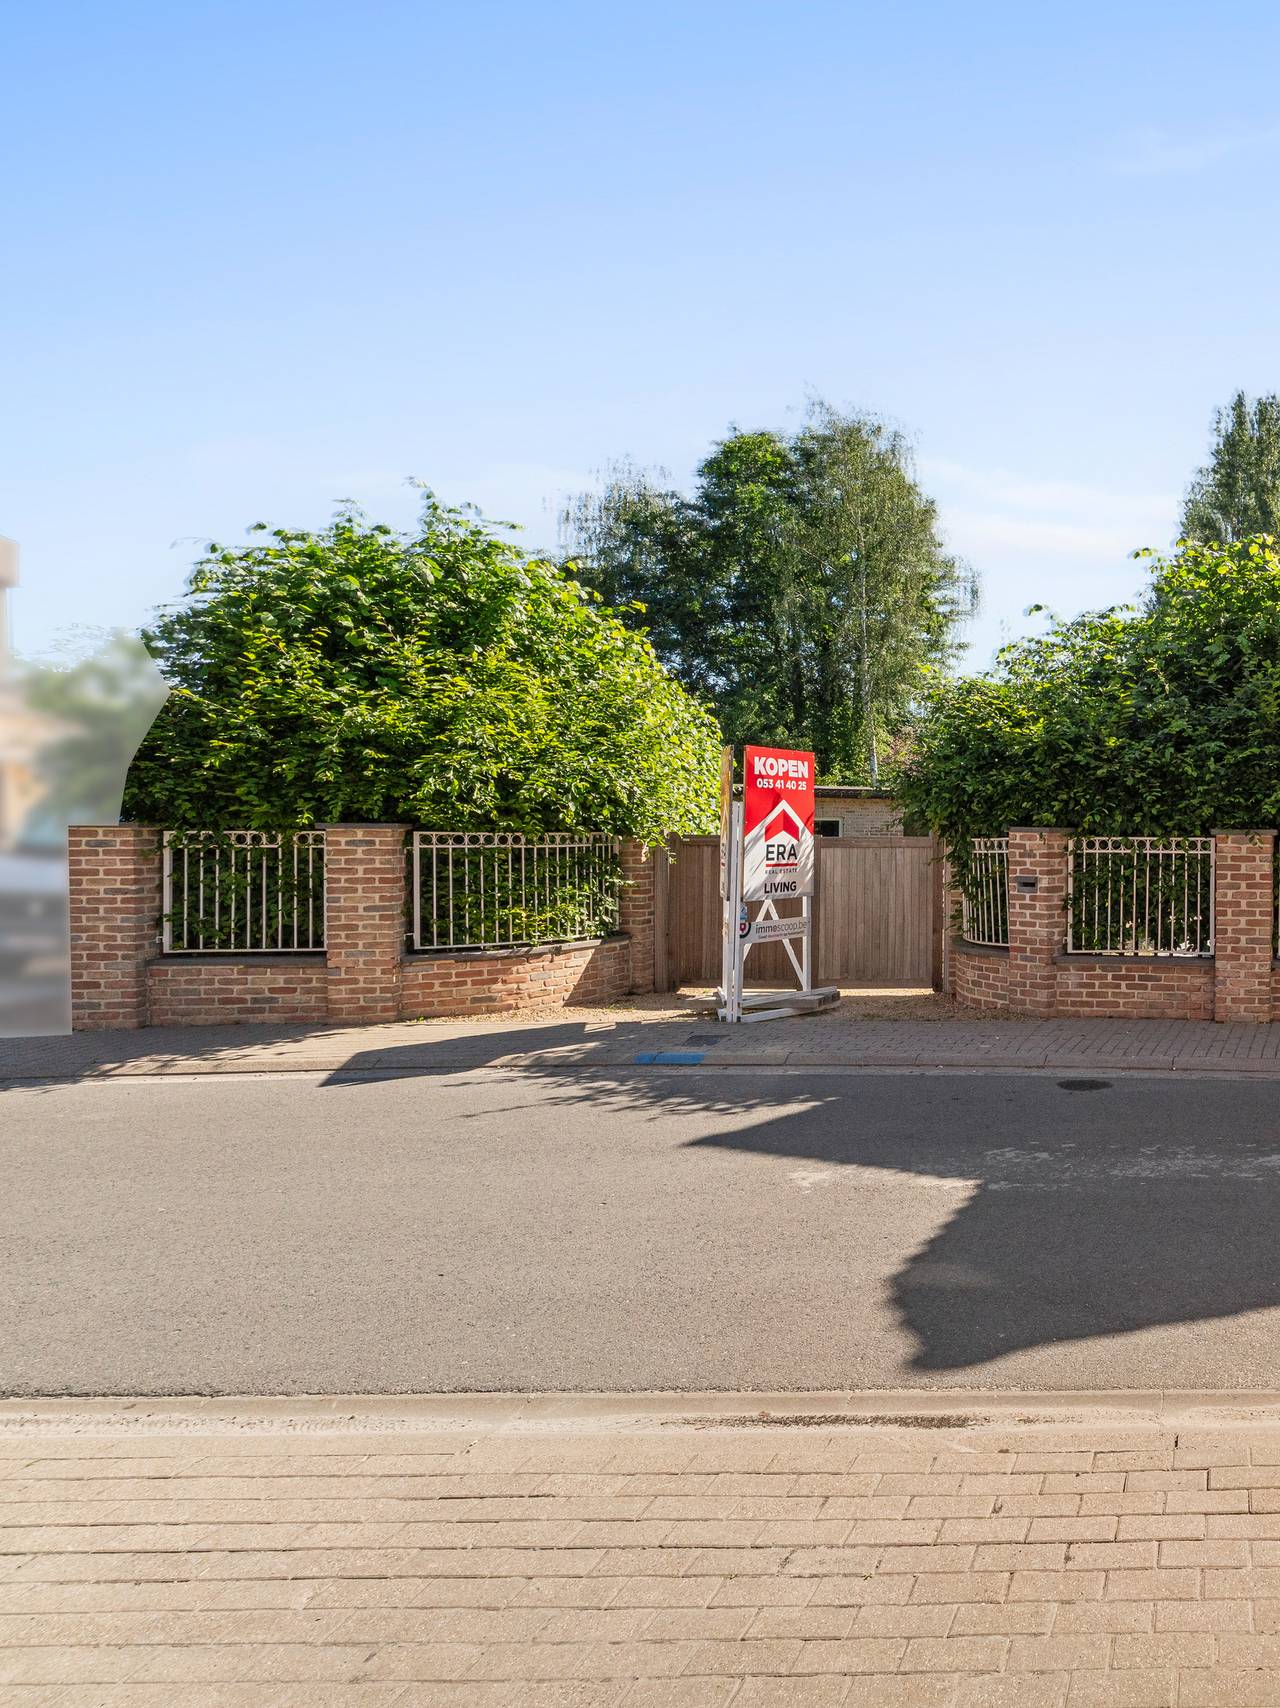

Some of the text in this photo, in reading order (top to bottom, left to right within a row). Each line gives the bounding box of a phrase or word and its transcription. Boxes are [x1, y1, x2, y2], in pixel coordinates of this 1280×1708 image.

[754, 756, 809, 779] KOPEN
[756, 778, 807, 791] 053 41 40 25
[765, 843, 798, 861] ERA
[764, 881, 797, 894] LIVING
